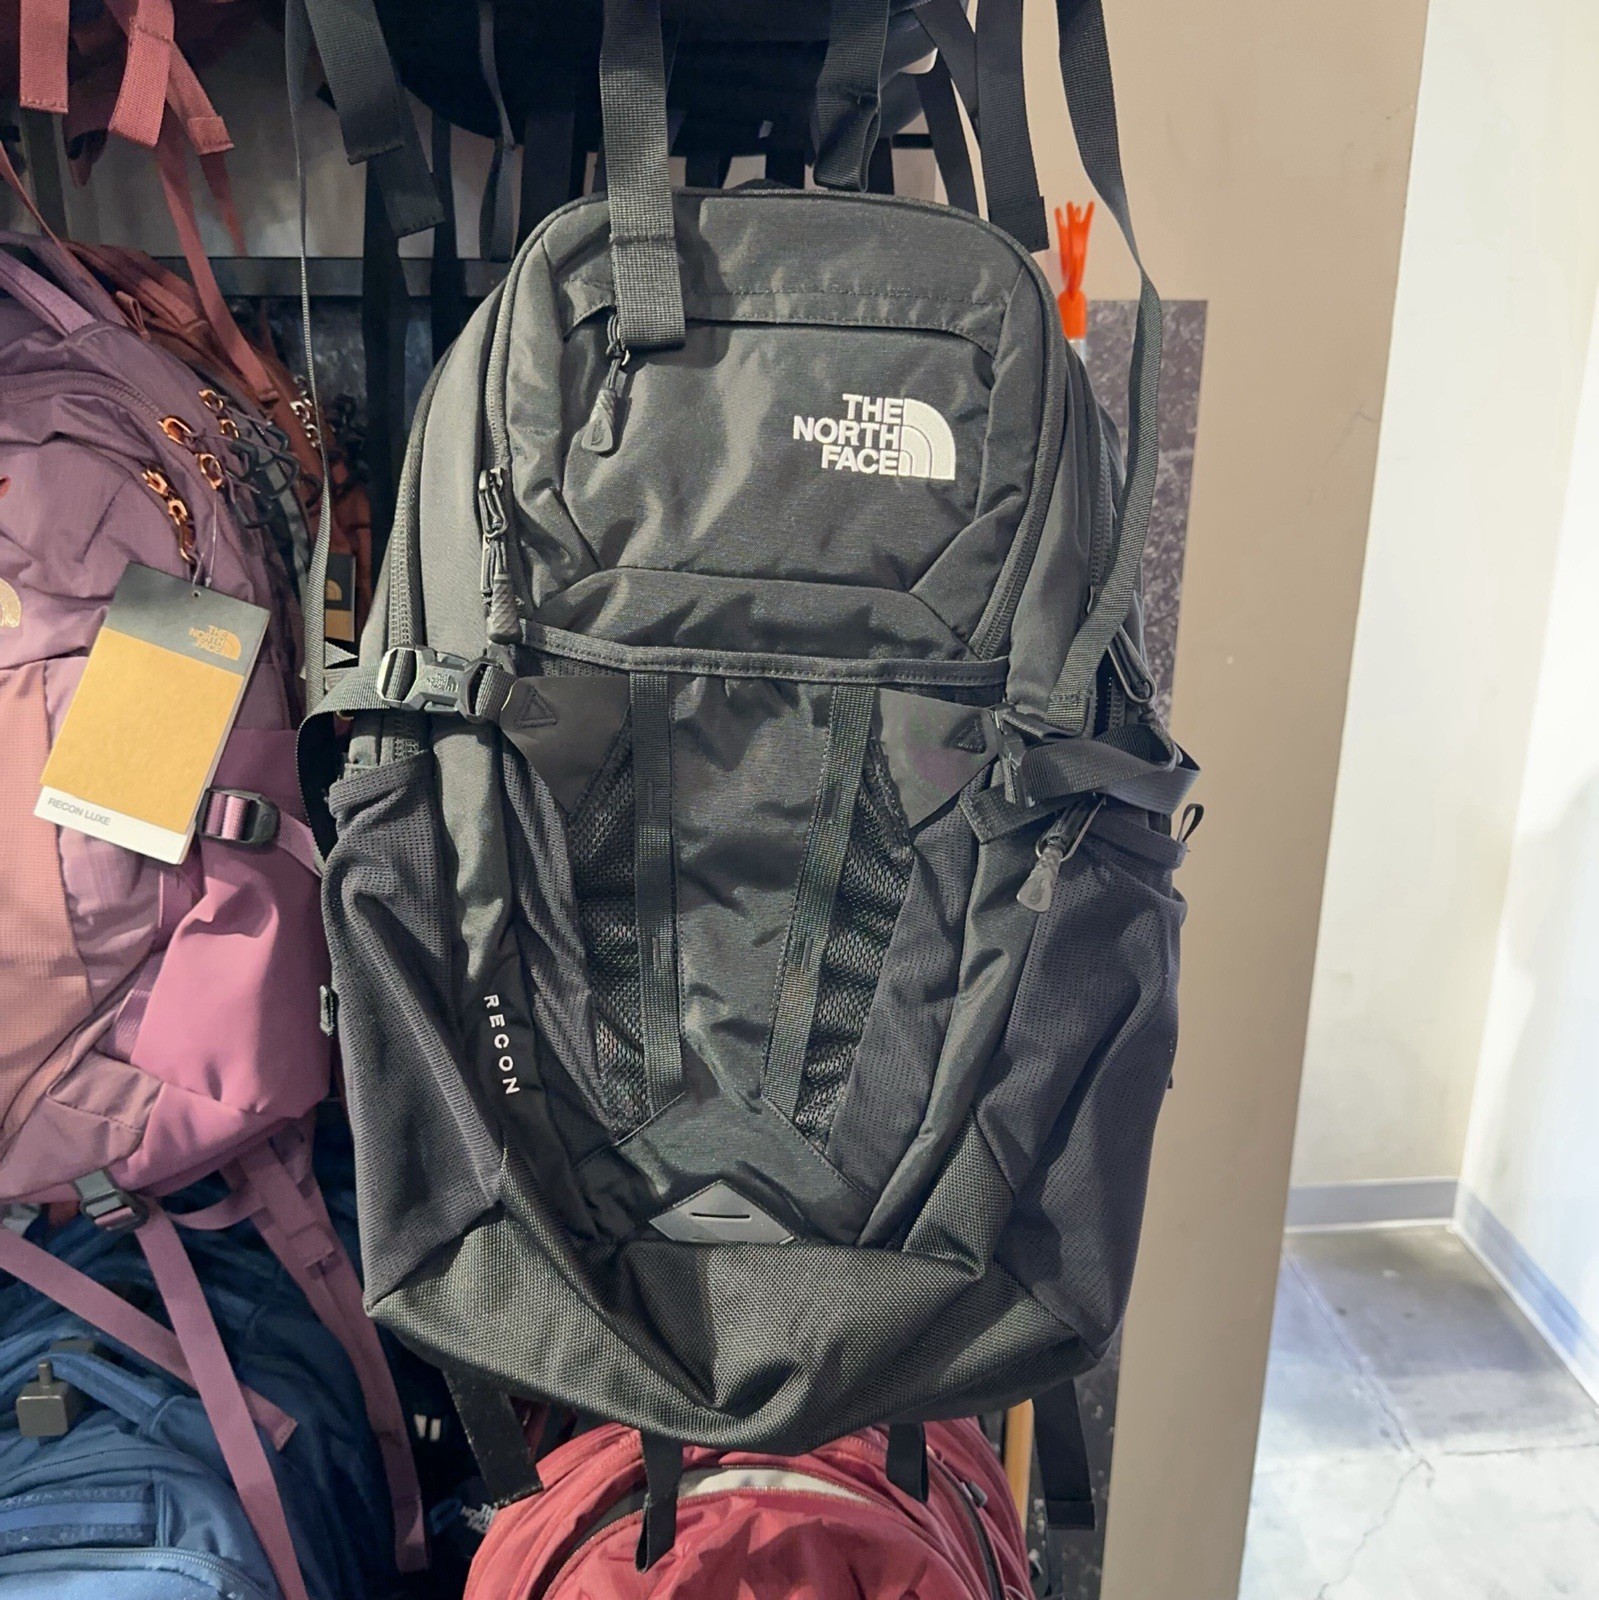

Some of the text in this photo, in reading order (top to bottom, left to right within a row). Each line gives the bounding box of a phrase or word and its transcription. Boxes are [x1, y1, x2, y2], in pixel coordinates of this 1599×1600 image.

[842, 393, 904, 424] THE
[792, 415, 900, 450] NORTH
[821, 444, 898, 476] FACE
[47, 797, 112, 826] RECON LUXE
[483, 994, 520, 1095] RECON
